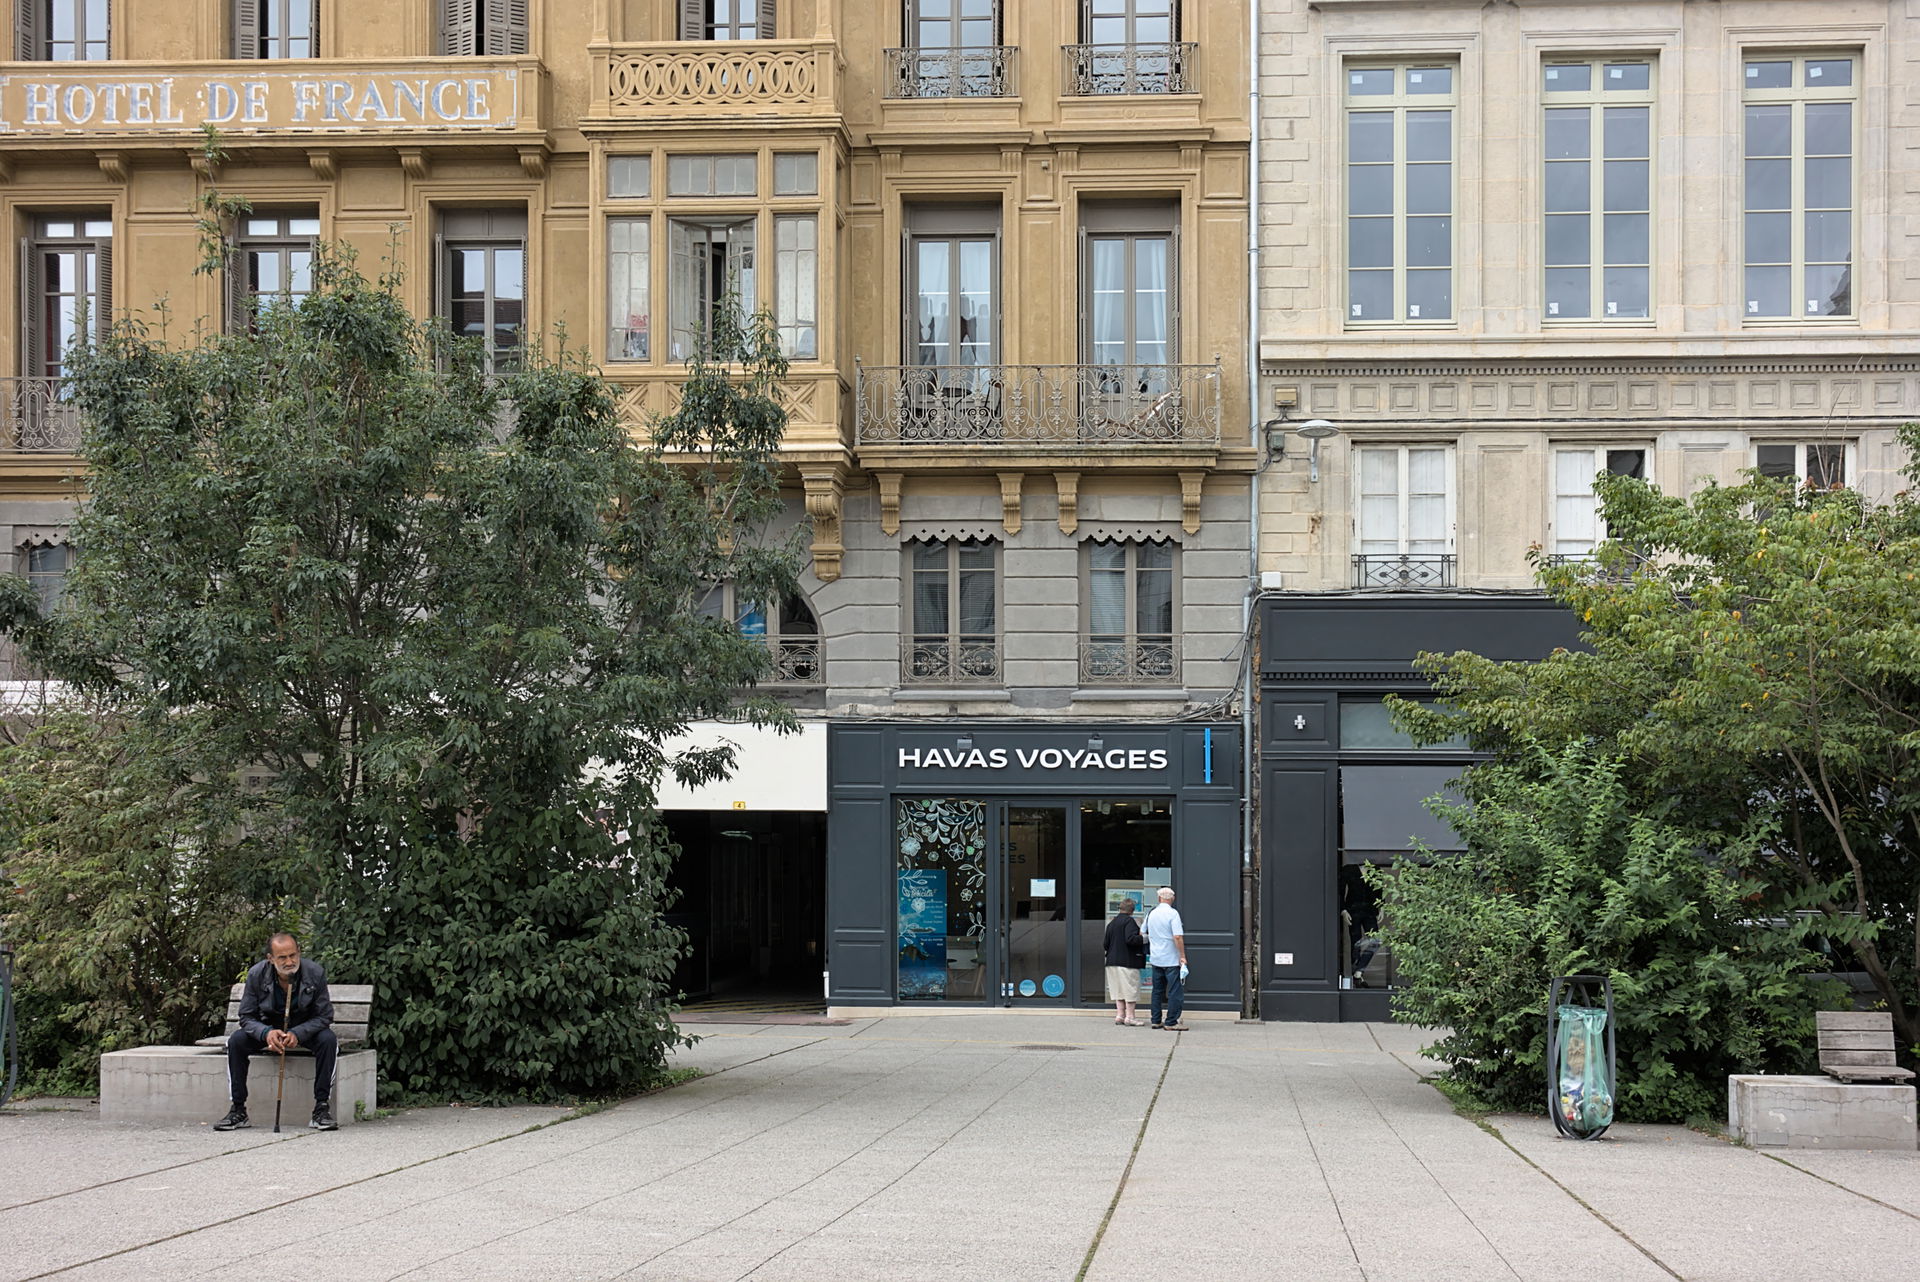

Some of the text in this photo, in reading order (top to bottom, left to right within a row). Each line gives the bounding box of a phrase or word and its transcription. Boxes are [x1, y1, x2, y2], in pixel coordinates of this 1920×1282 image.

[23, 79, 491, 125] HOTEL DE FRANCE
[898, 748, 1169, 769] HAVAS VOYAGES
